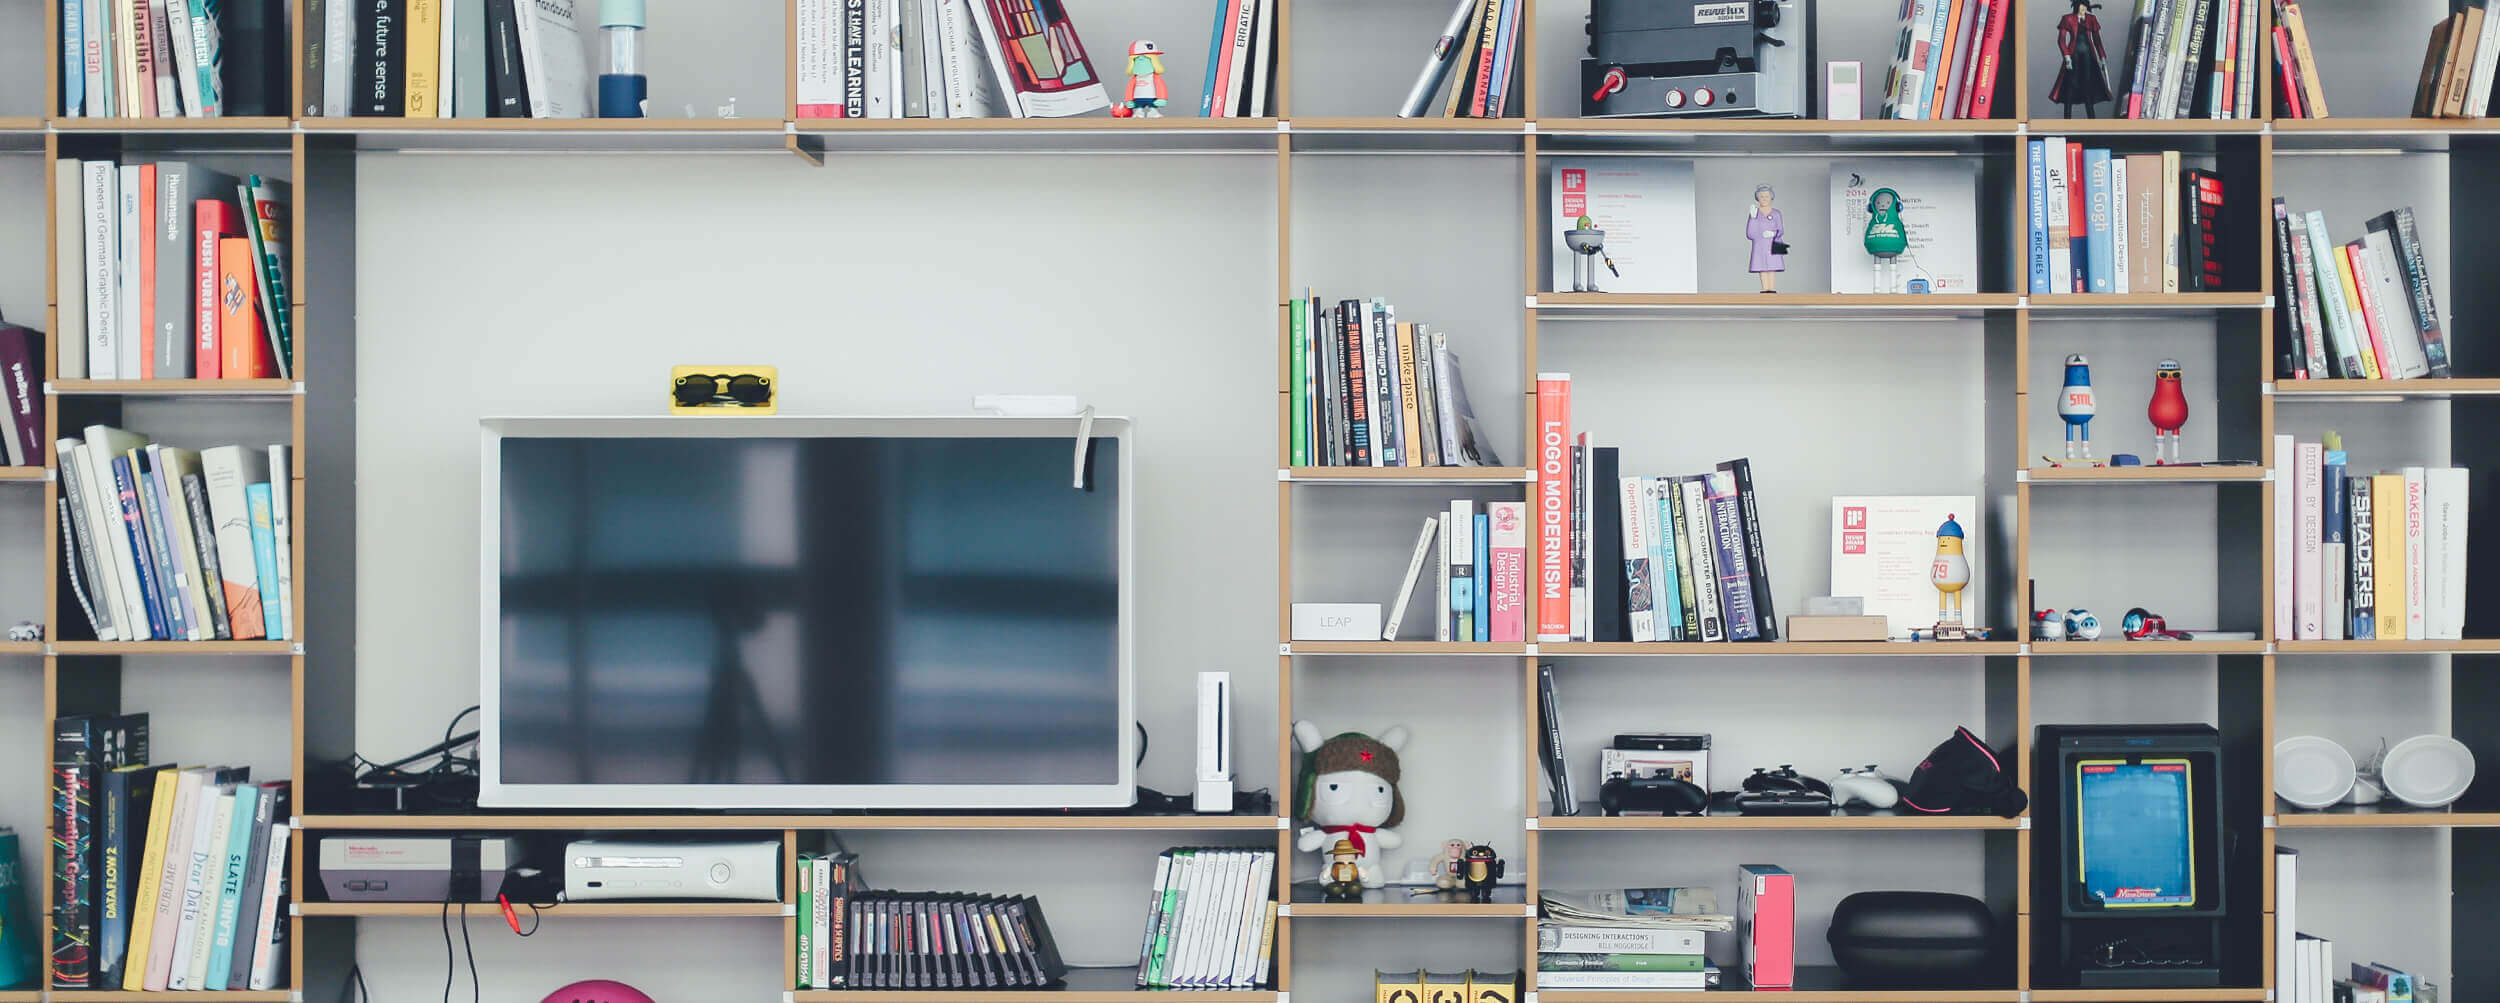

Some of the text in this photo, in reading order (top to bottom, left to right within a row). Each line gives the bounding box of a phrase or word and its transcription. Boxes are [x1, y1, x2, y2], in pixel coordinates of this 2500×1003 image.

[191, 16, 209, 67] MEGATECH
[376, 16, 391, 57] future
[852, 18, 861, 46] HAVE
[1236, 4, 1250, 48] ERRATIC
[1932, 12, 1947, 46] Usability
[2190, 24, 2205, 54] design
[946, 8, 960, 98] BLOCKCHAIN REVOLUTION
[375, 61, 388, 100] sense
[848, 47, 861, 118] LEARNED
[2049, 168, 2066, 190] art
[2090, 160, 2107, 232] Van Gogh
[167, 174, 181, 241] Humanscale
[2032, 145, 2045, 274] THE LEAN STARTUP ERIC RIES
[2115, 194, 2125, 242] Proposition
[95, 165, 111, 348] Pioneers of German Graphic Design
[2116, 244, 2126, 273] Design
[2414, 255, 2427, 279] Oxford
[201, 230, 213, 349] PUSH TURN MOVE
[2410, 277, 2430, 331] PSYCHOLOGY
[2418, 279, 2433, 313] Handbook
[1379, 377, 1388, 394] Das
[1400, 344, 1415, 410] make space
[2069, 393, 2093, 407] SML
[1544, 421, 1561, 599] LOGO MODERNISM
[1627, 482, 1641, 549] OpenStreetMap
[1717, 501, 1732, 550] INTERACTION
[2305, 446, 2316, 553] DIGITAL BY DESIGN
[2442, 502, 2450, 522] Steve
[1694, 487, 1713, 605] STEAL THIS COMPUTER BOOK
[2356, 495, 2373, 608] SHADERS
[2409, 481, 2420, 606] MAKERS CHRIS ANDERSON
[2442, 524, 2450, 541] Jobs
[1494, 551, 1508, 612] Design A-Z
[1508, 552, 1521, 606] Industrial
[1932, 563, 1948, 579] 79
[1319, 617, 1352, 628] LEAP
[64, 768, 81, 858] Information
[106, 855, 118, 919] DATAFLOW
[159, 861, 178, 915] SUBLIME
[184, 851, 209, 921] Dear Data
[195, 812, 226, 960] TUFTE VISUAL EXPLANATIONS
[217, 853, 242, 947] SLATE BLANK
[800, 933, 809, 951] CUP
[1563, 932, 1649, 941] DESIGNING INTERACTIONS
[1598, 942, 1649, 950] BILL MOGGRIDGE
[1587, 976, 1623, 984] Principles
[1631, 976, 1655, 984] Design
